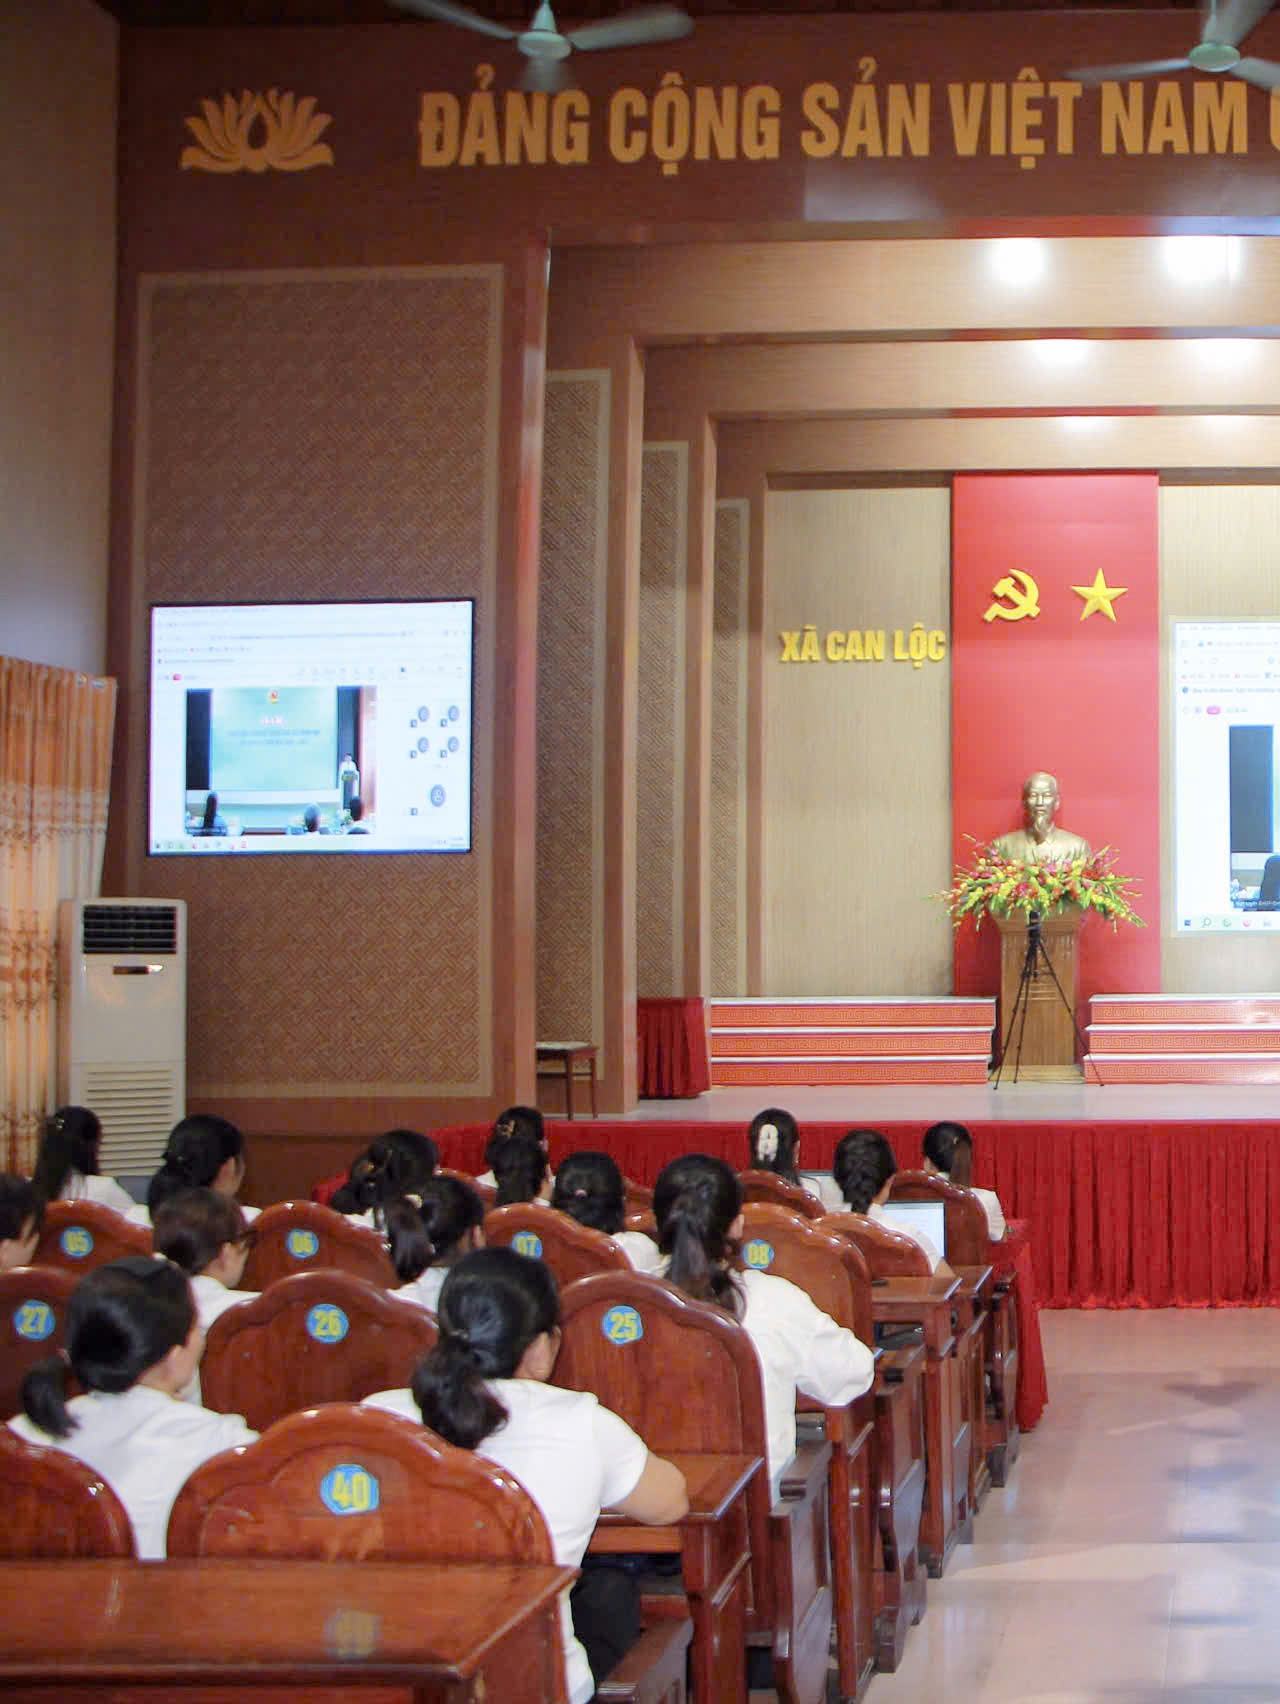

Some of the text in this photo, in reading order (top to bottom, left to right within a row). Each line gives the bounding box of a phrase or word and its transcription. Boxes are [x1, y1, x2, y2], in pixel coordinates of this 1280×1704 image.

[419, 63, 589, 166] ĐẢNG
[608, 72, 782, 175] CỘNG
[800, 57, 931, 158] SẢN
[947, 67, 1084, 169] VIỆT
[1100, 81, 1249, 155] NAM
[781, 622, 945, 669] XÃ CAN LỘC
[21, 1307, 47, 1334] 27
[315, 1310, 341, 1337] 26
[609, 1313, 637, 1340] 25
[332, 1472, 370, 1511] 40
